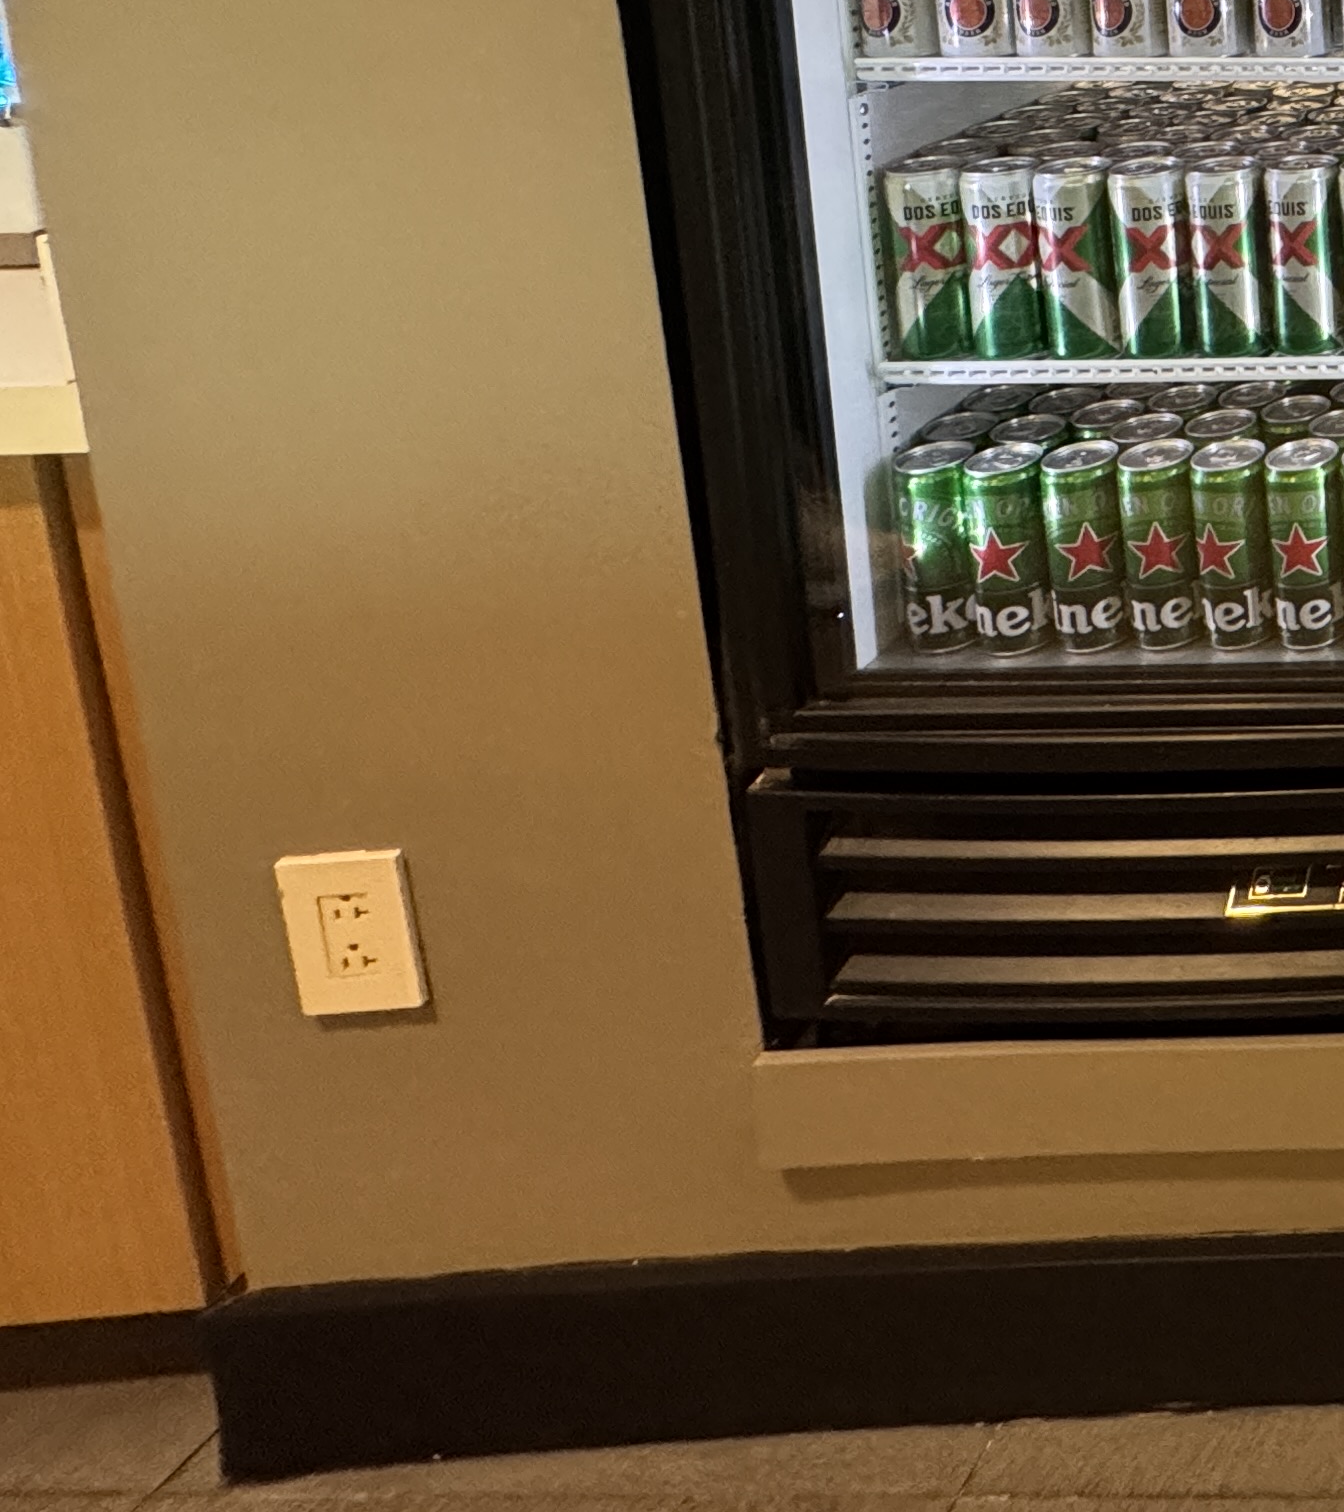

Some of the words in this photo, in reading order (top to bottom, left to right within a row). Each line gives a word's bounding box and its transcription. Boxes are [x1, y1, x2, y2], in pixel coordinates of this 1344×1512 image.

[904, 206, 936, 221] DOS
[972, 204, 1002, 220] DOS
[1131, 205, 1163, 222] DOS
[1271, 218, 1319, 266] X
